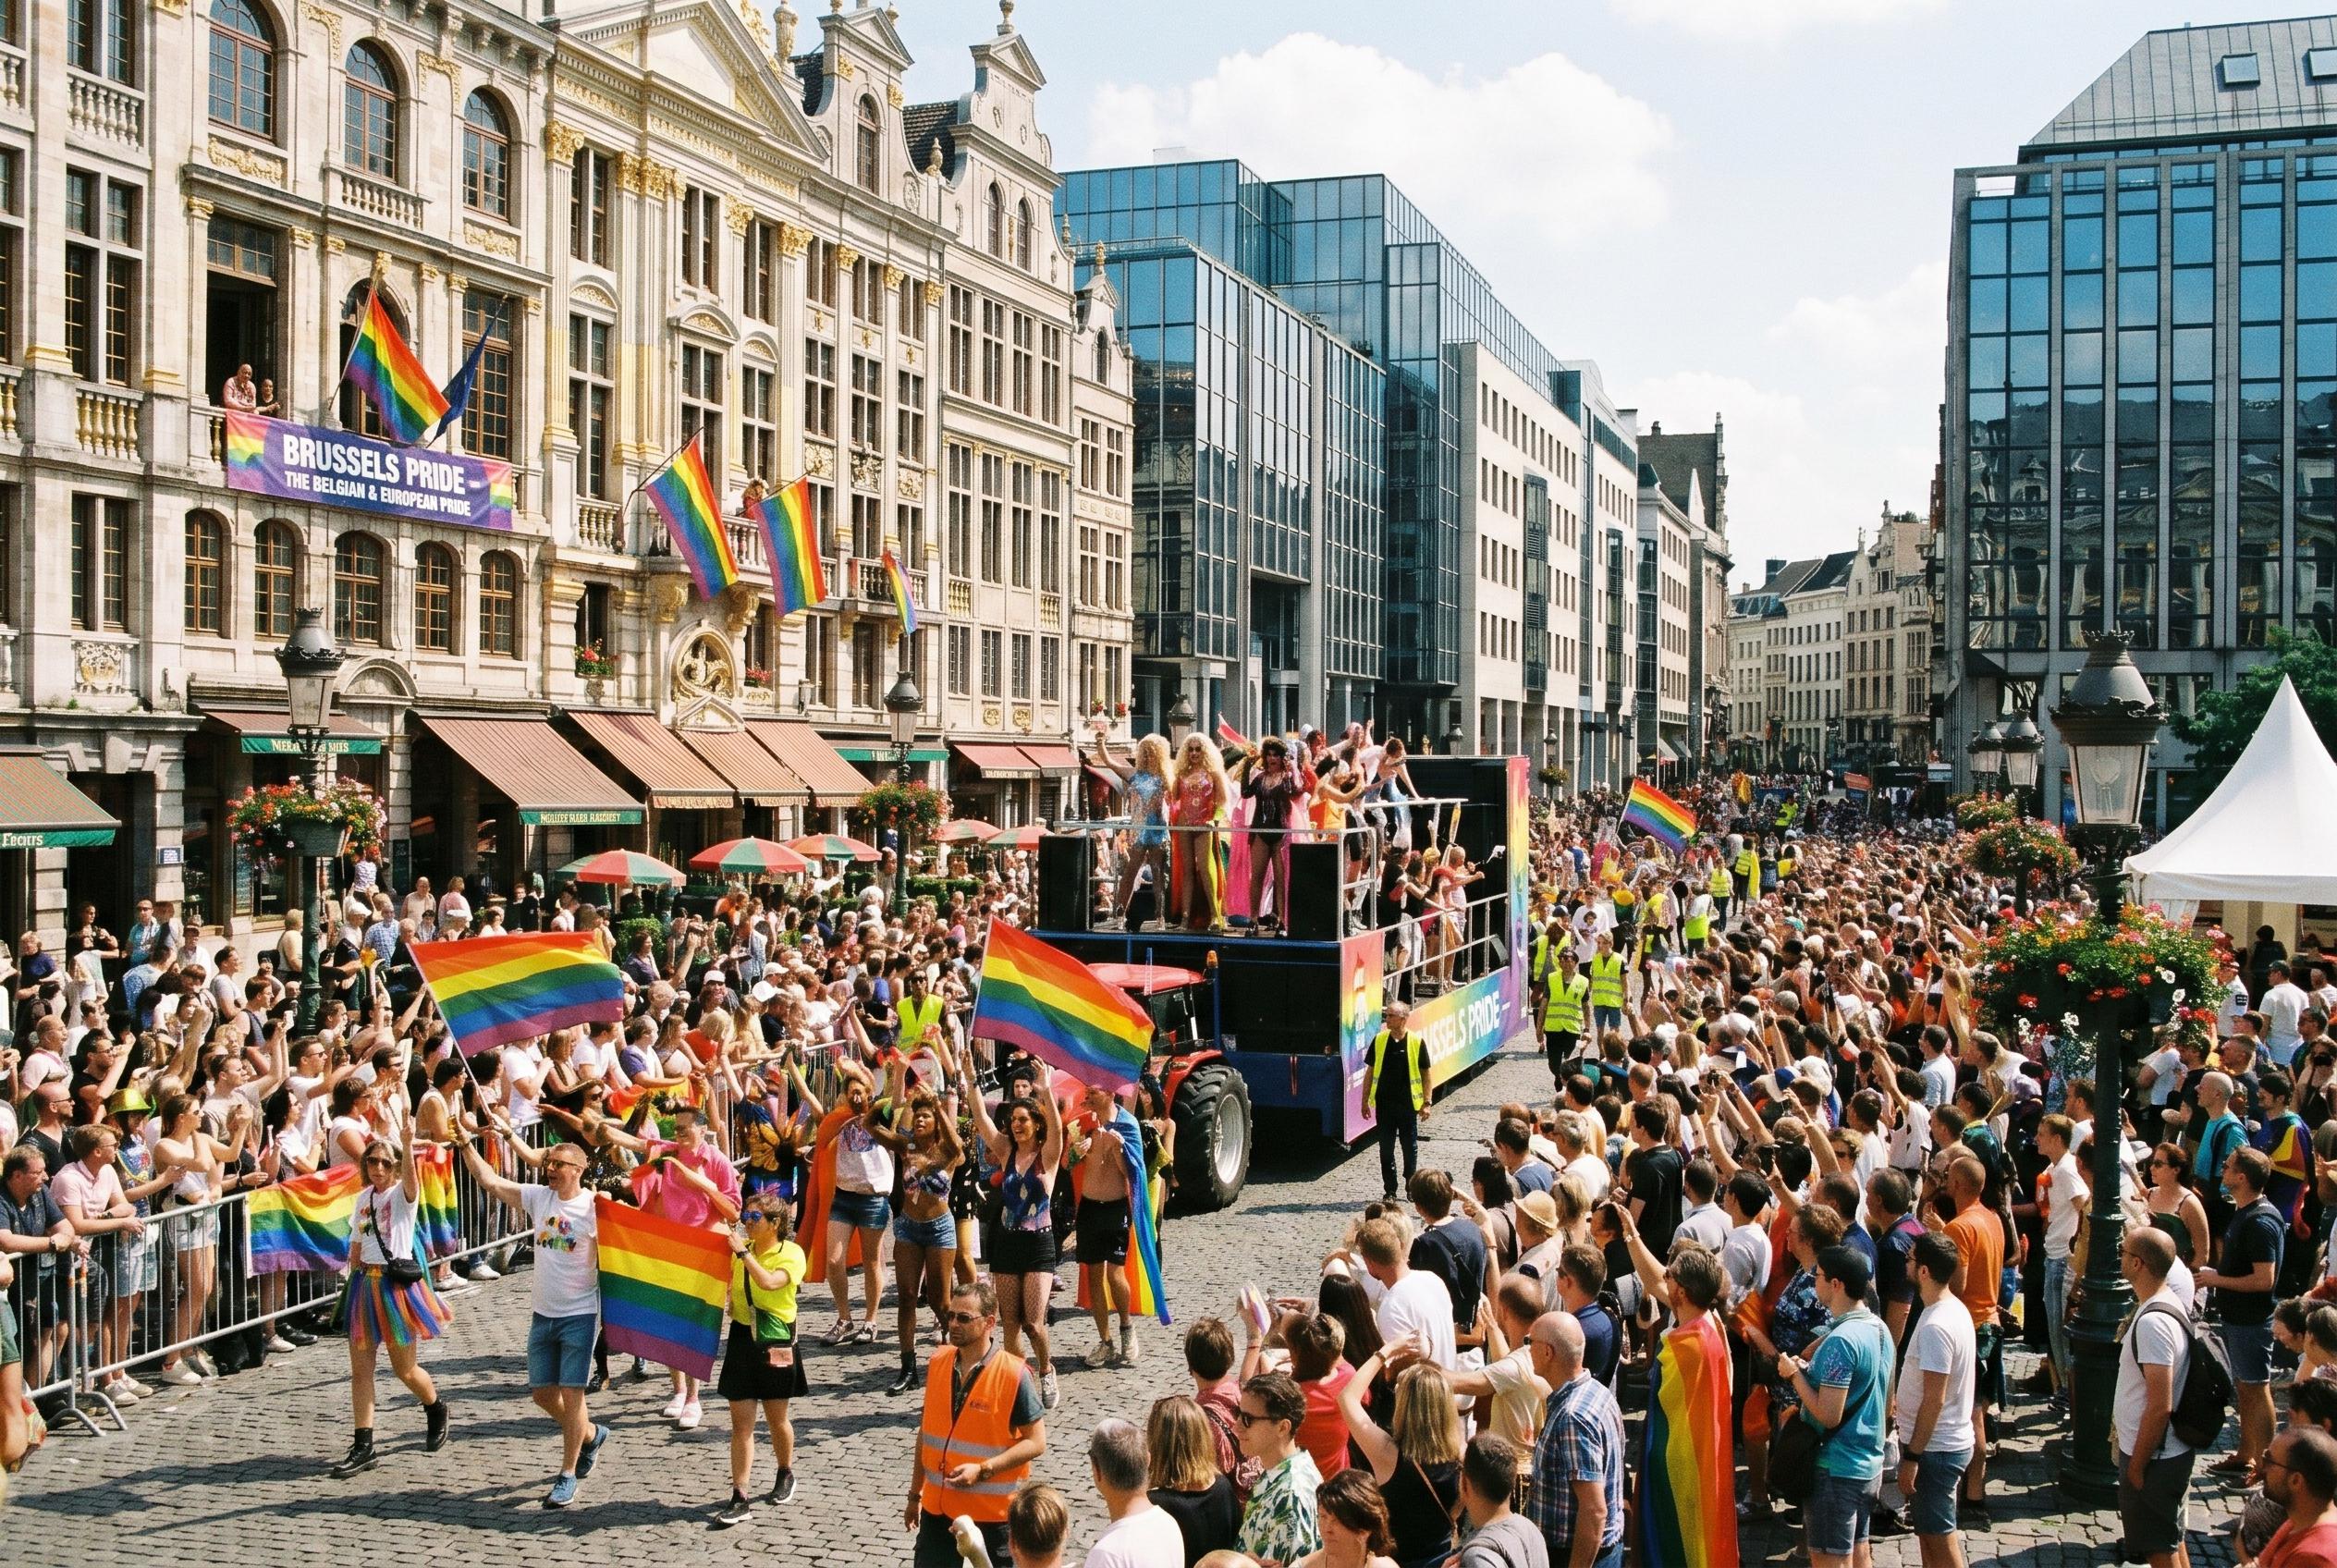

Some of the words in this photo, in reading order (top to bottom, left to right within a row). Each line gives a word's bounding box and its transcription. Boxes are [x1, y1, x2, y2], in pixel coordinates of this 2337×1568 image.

[283, 434, 400, 484] BRUSSELS
[406, 457, 465, 495] PRIDE
[285, 471, 311, 490] THE
[312, 474, 366, 499] BELGIAN
[368, 484, 377, 501] &
[380, 486, 438, 511] EUROPEAN
[439, 497, 471, 516] PRIDE
[1468, 990, 1500, 1045] PRIDE
